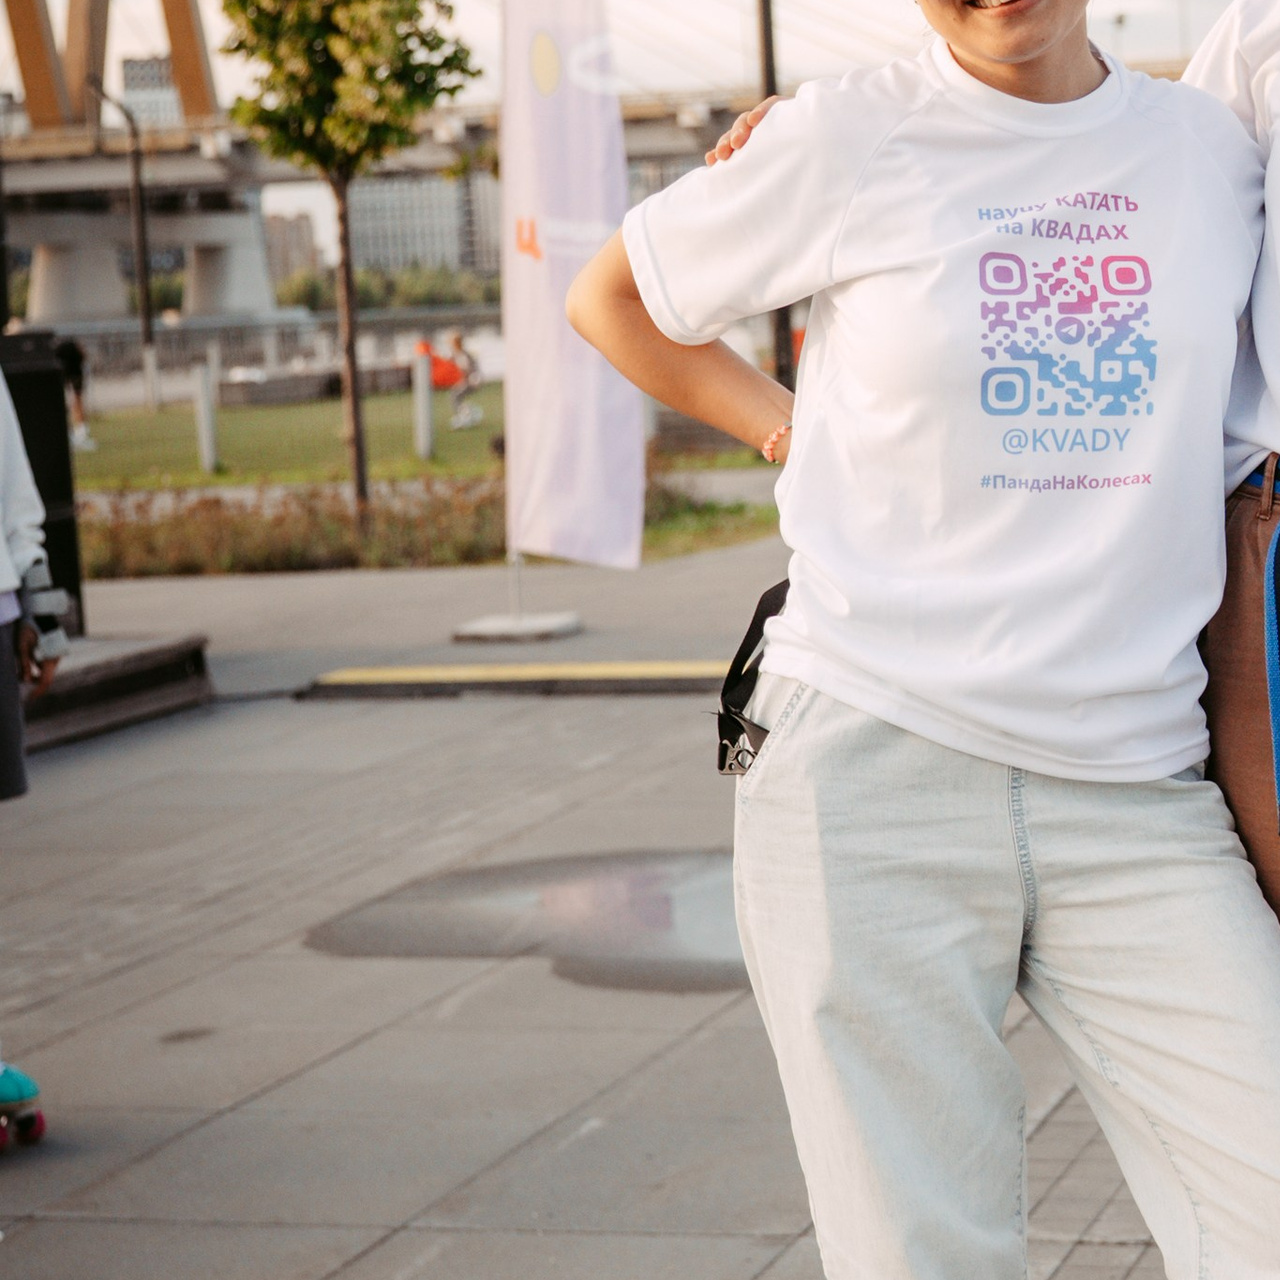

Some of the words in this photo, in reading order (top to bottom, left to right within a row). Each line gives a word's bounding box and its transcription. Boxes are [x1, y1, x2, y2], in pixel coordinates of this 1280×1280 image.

[1055, 191, 1139, 212] КАТАТЬ
[996, 221, 1024, 235] на
[1031, 218, 1130, 244] КВАДАХ
[1002, 427, 1132, 455] @KVADY
[980, 472, 1152, 493] #ПандаНаКолесах
